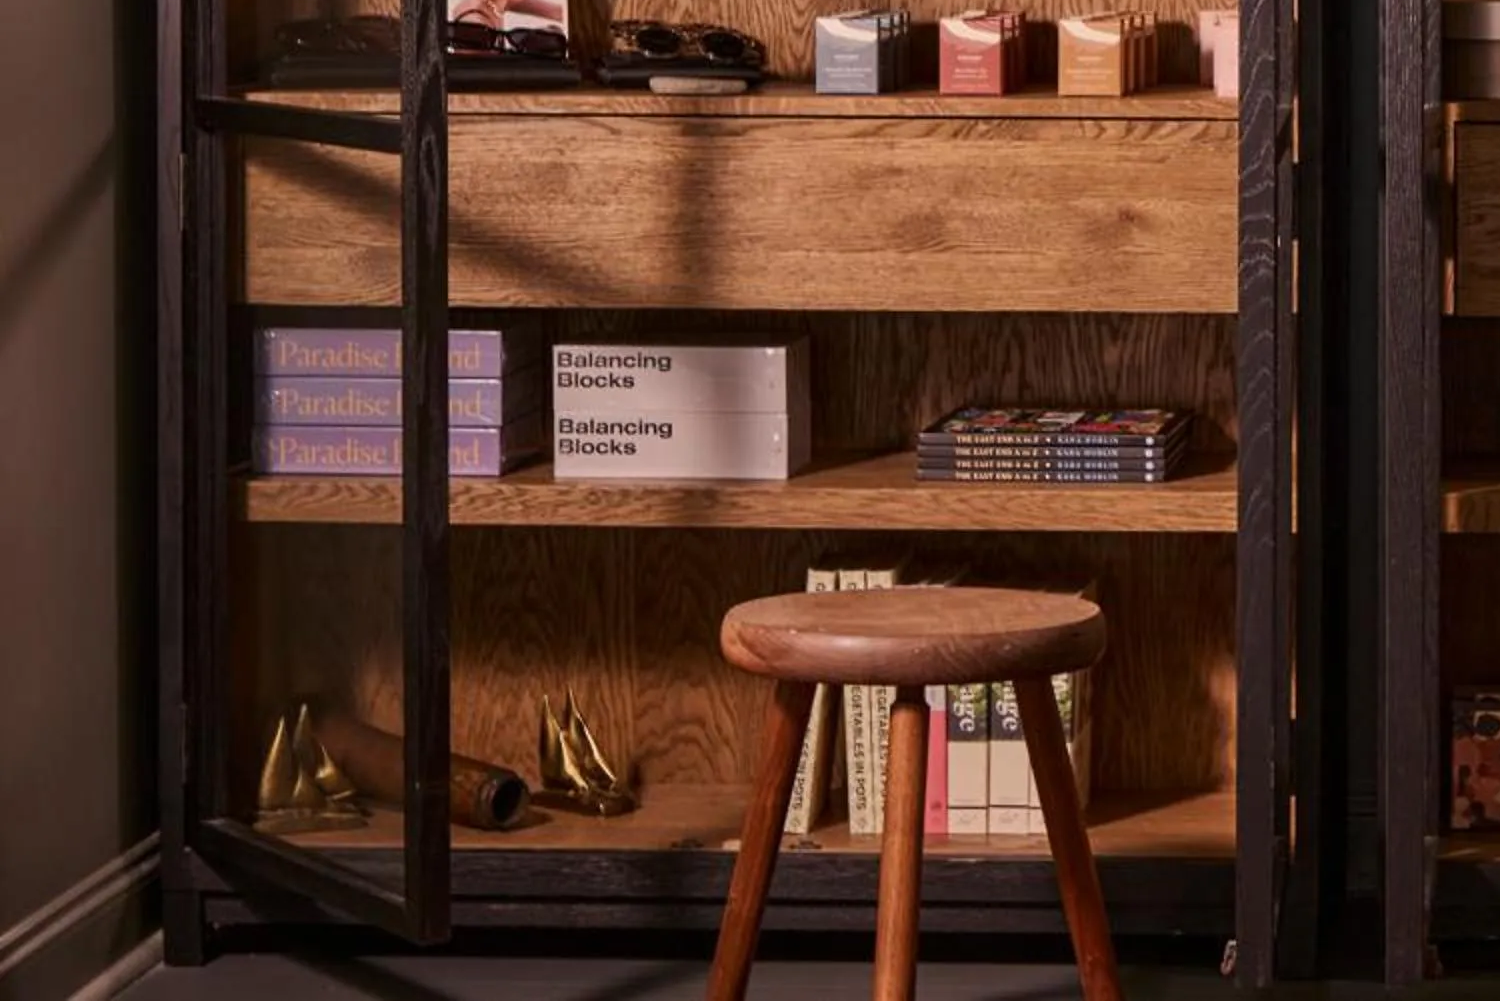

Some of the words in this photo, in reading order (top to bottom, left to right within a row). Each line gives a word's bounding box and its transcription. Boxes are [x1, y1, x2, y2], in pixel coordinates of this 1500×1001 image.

[280, 339, 387, 370] Paradise
[558, 351, 672, 372] Balancing
[558, 372, 635, 388] Blocks
[281, 387, 390, 417] Paradise
[560, 418, 673, 439] Balancing
[279, 436, 387, 466] Paradise
[560, 438, 637, 455] Blocks
[850, 686, 865, 758] EGETABLES
